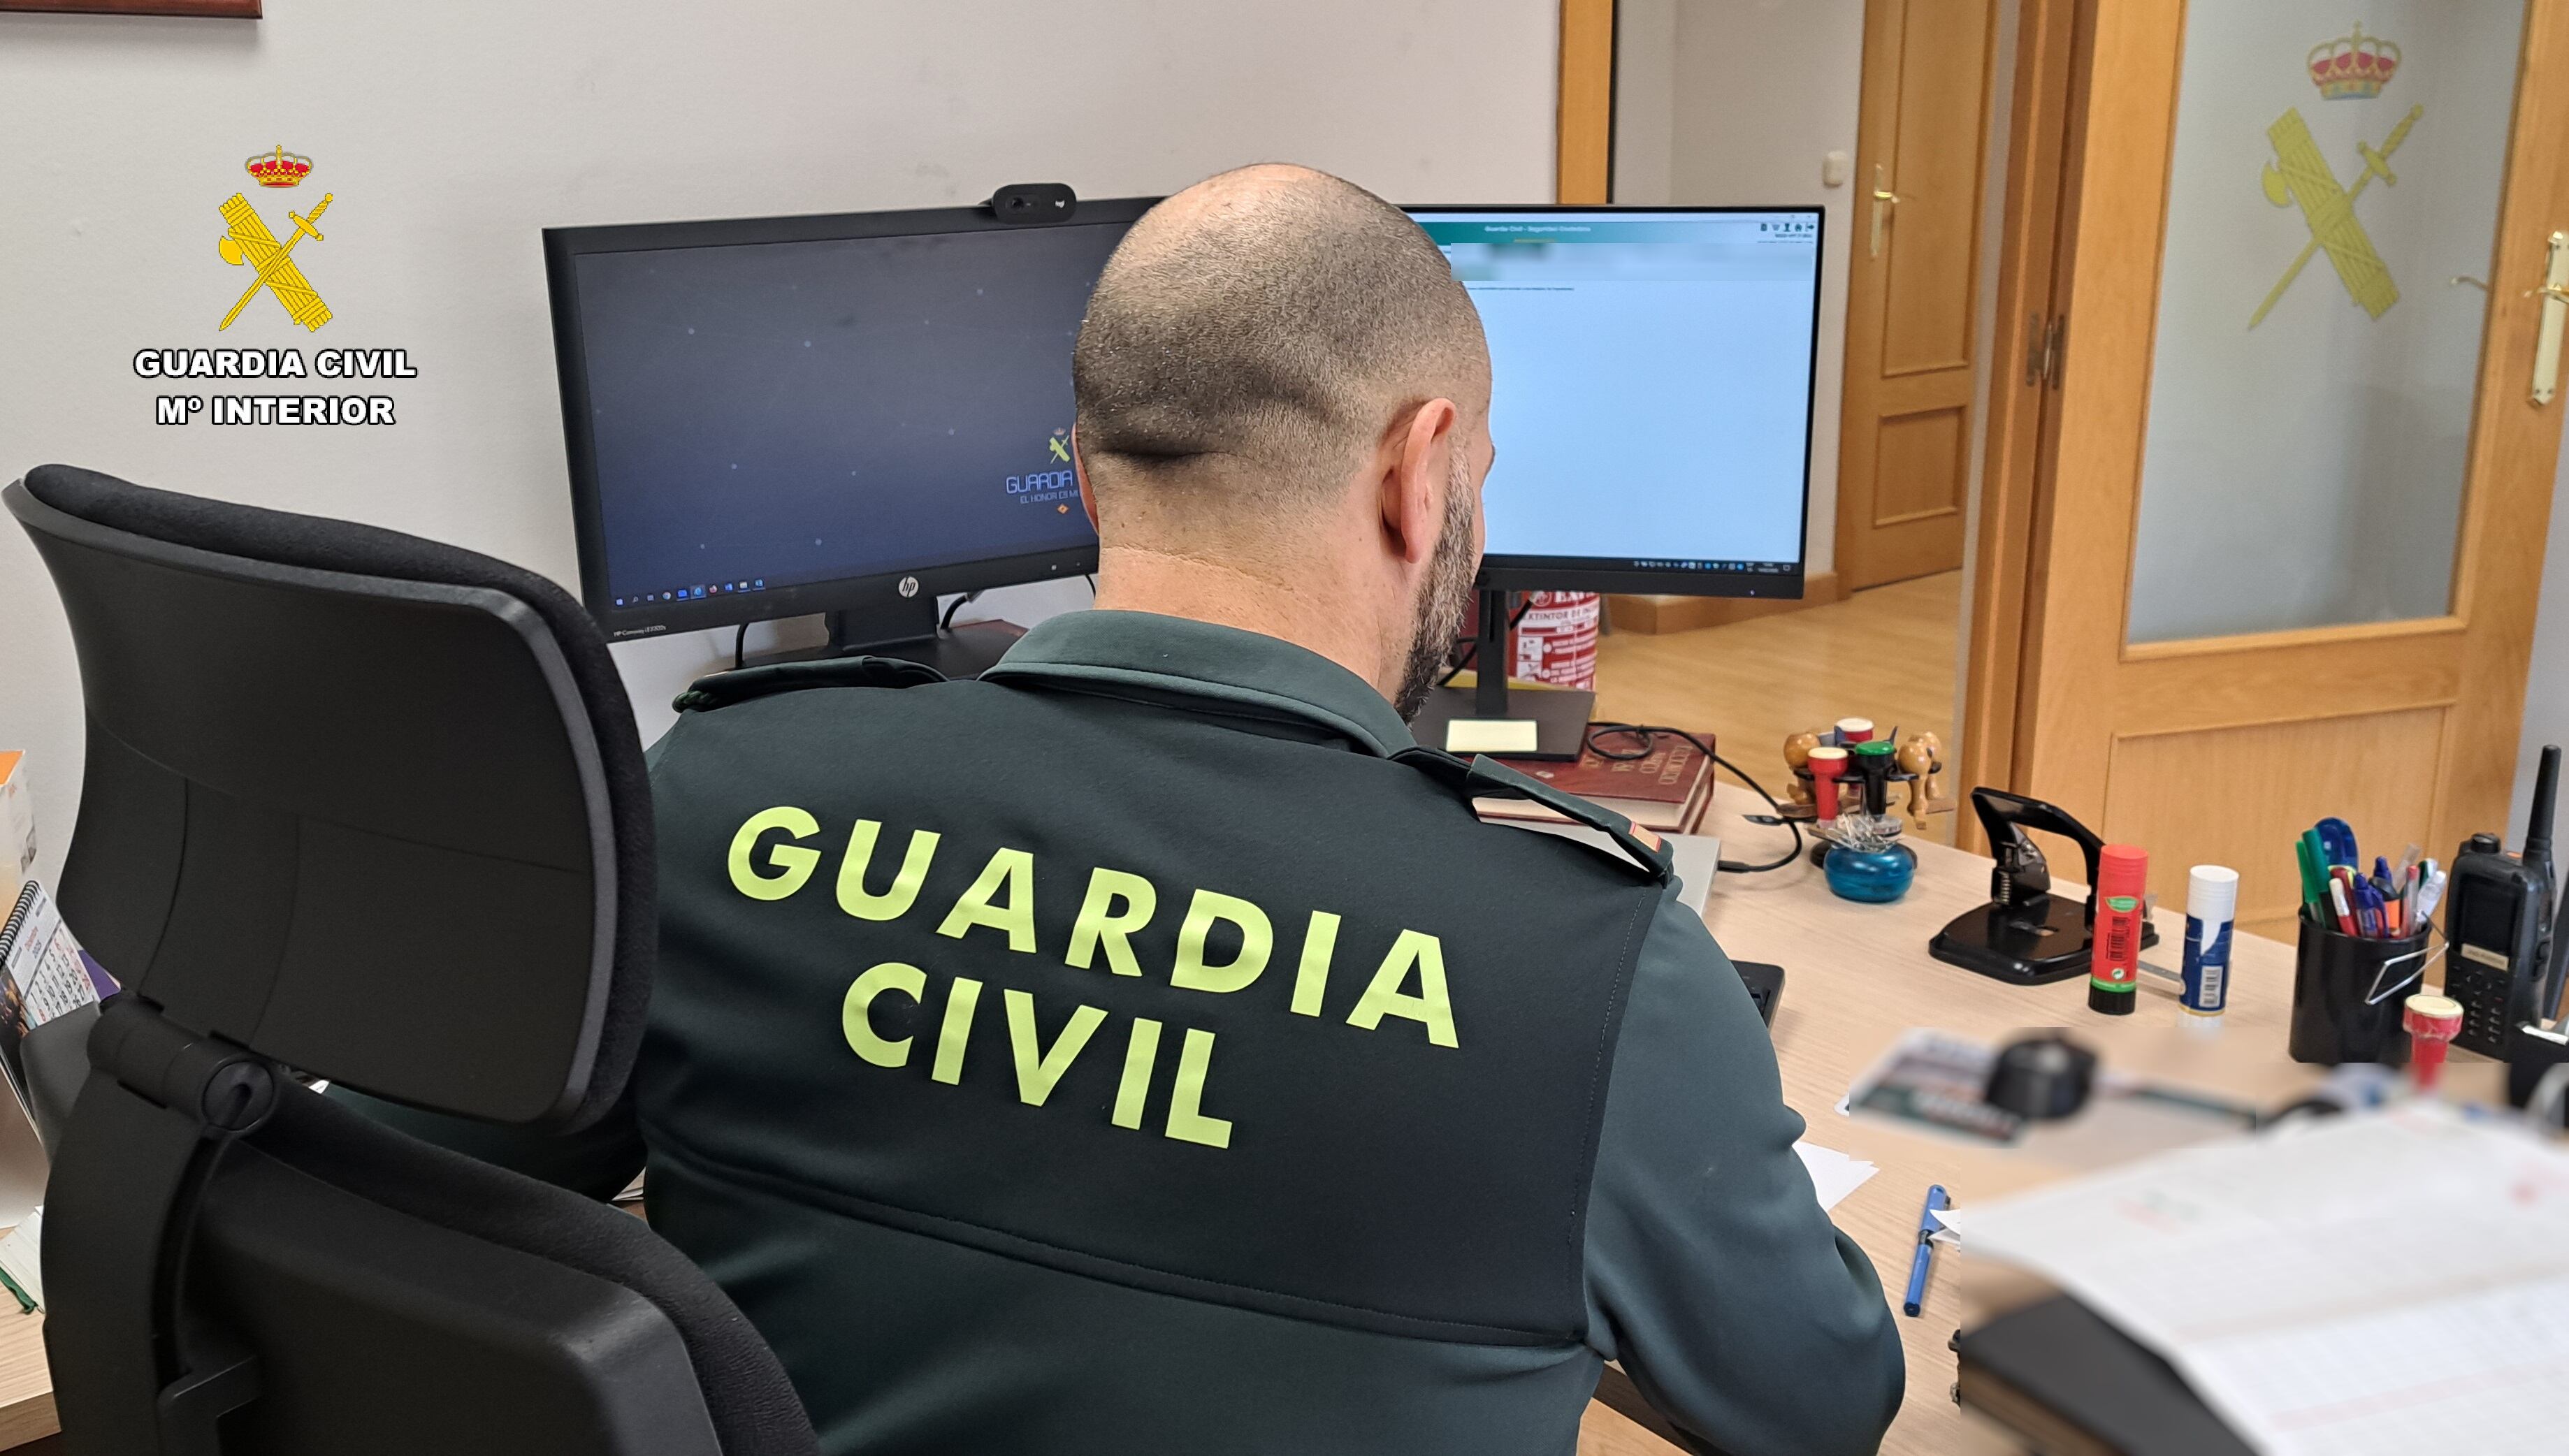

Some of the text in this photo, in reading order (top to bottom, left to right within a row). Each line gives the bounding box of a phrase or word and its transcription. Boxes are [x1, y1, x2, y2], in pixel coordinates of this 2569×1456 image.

[1006, 470, 1073, 494] GUARDIA
[902, 577, 916, 597] hp
[727, 806, 1459, 1049] GUARDIA
[47, 985, 55, 999] 10
[52, 975, 59, 989] 11
[57, 964, 65, 977] 12
[61, 954, 70, 966] 13
[59, 991, 68, 1005] 18
[64, 980, 73, 993] 19
[70, 969, 78, 984] 20
[842, 961, 1233, 1149] CIVIL
